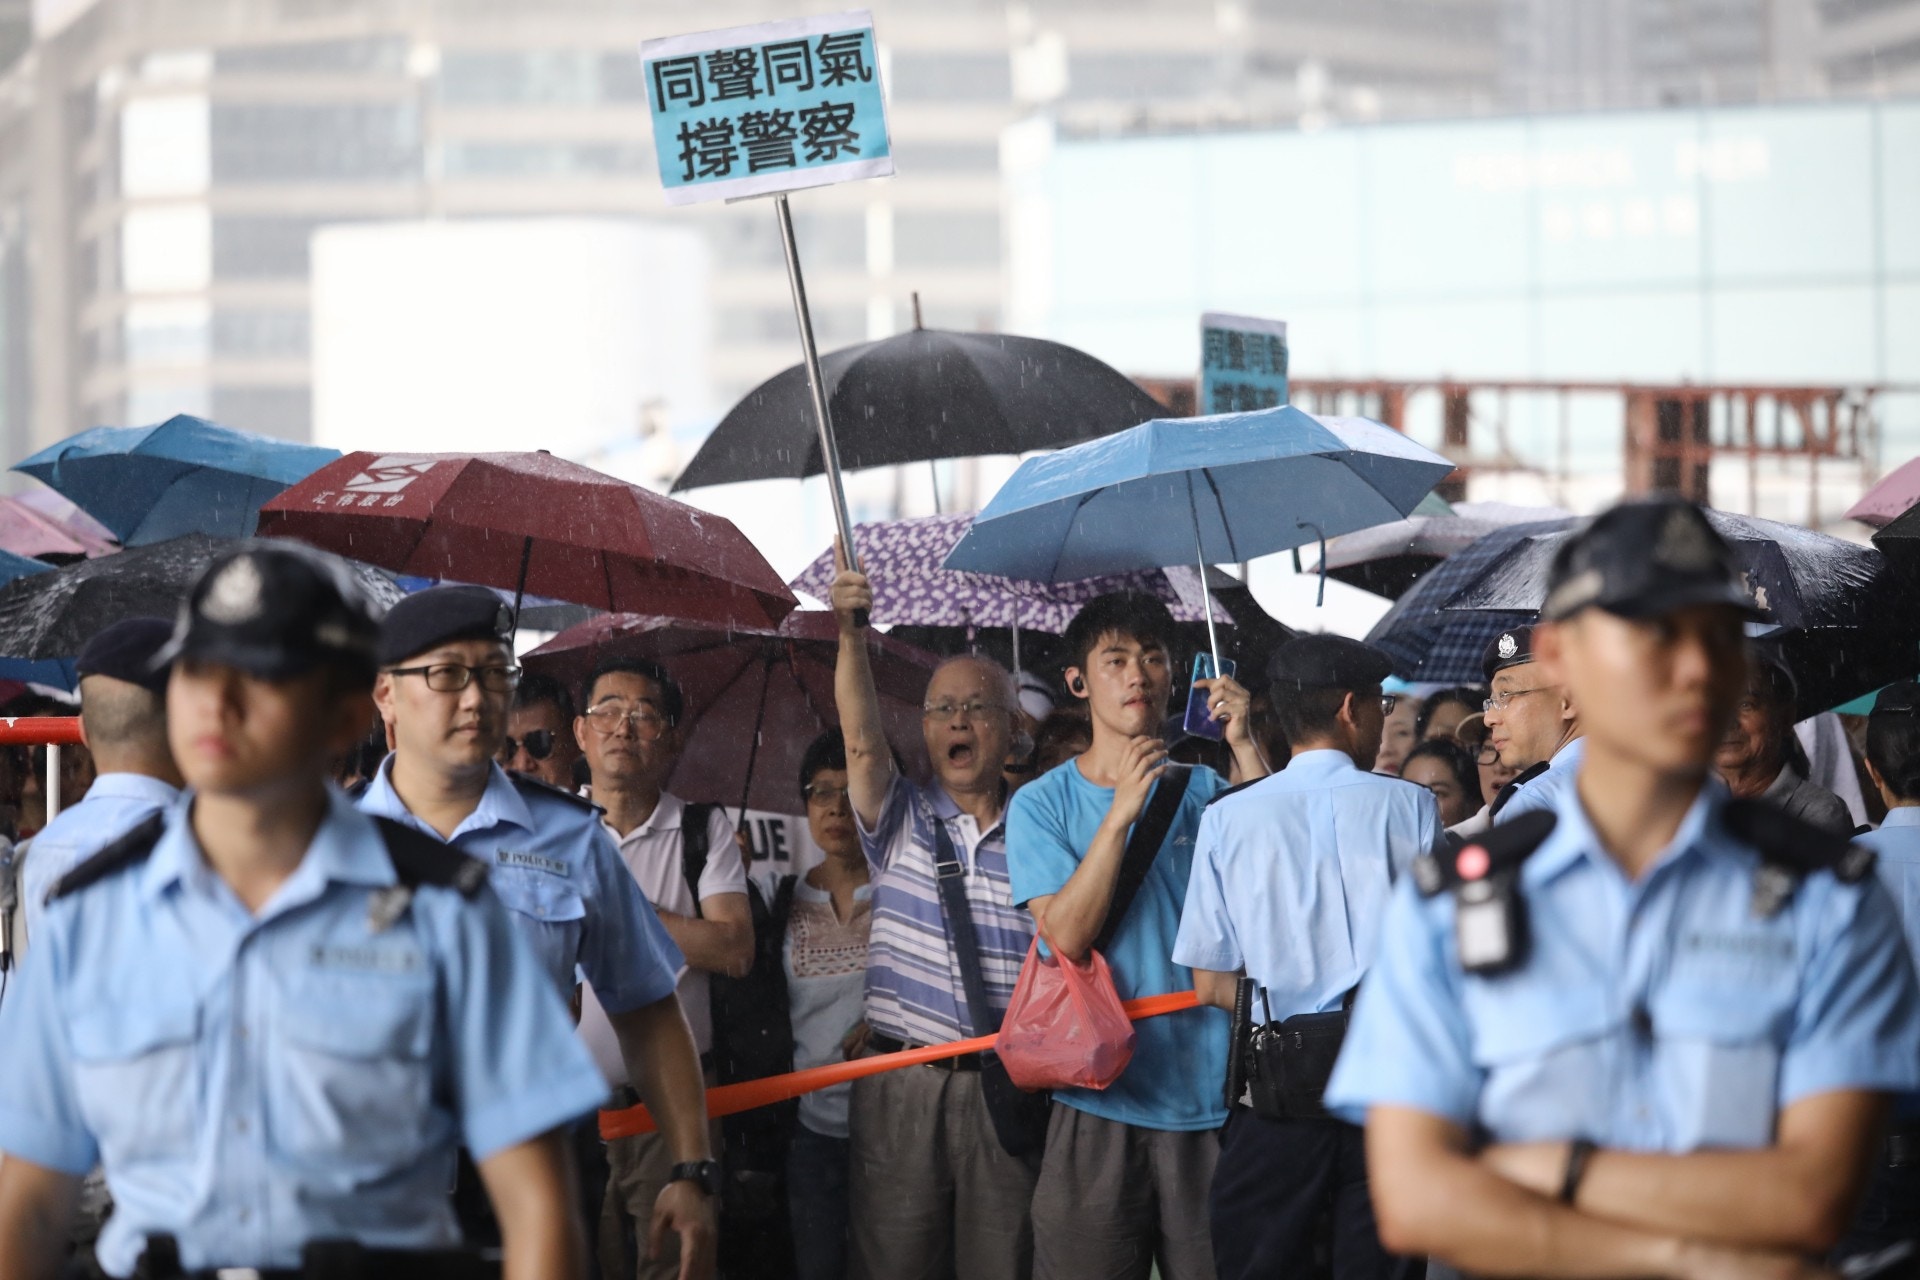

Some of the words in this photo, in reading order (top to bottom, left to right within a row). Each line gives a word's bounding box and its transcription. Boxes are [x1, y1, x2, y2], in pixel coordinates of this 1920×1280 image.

[652, 32, 872, 113] 同聲同氣
[676, 100, 862, 182] 撐警察
